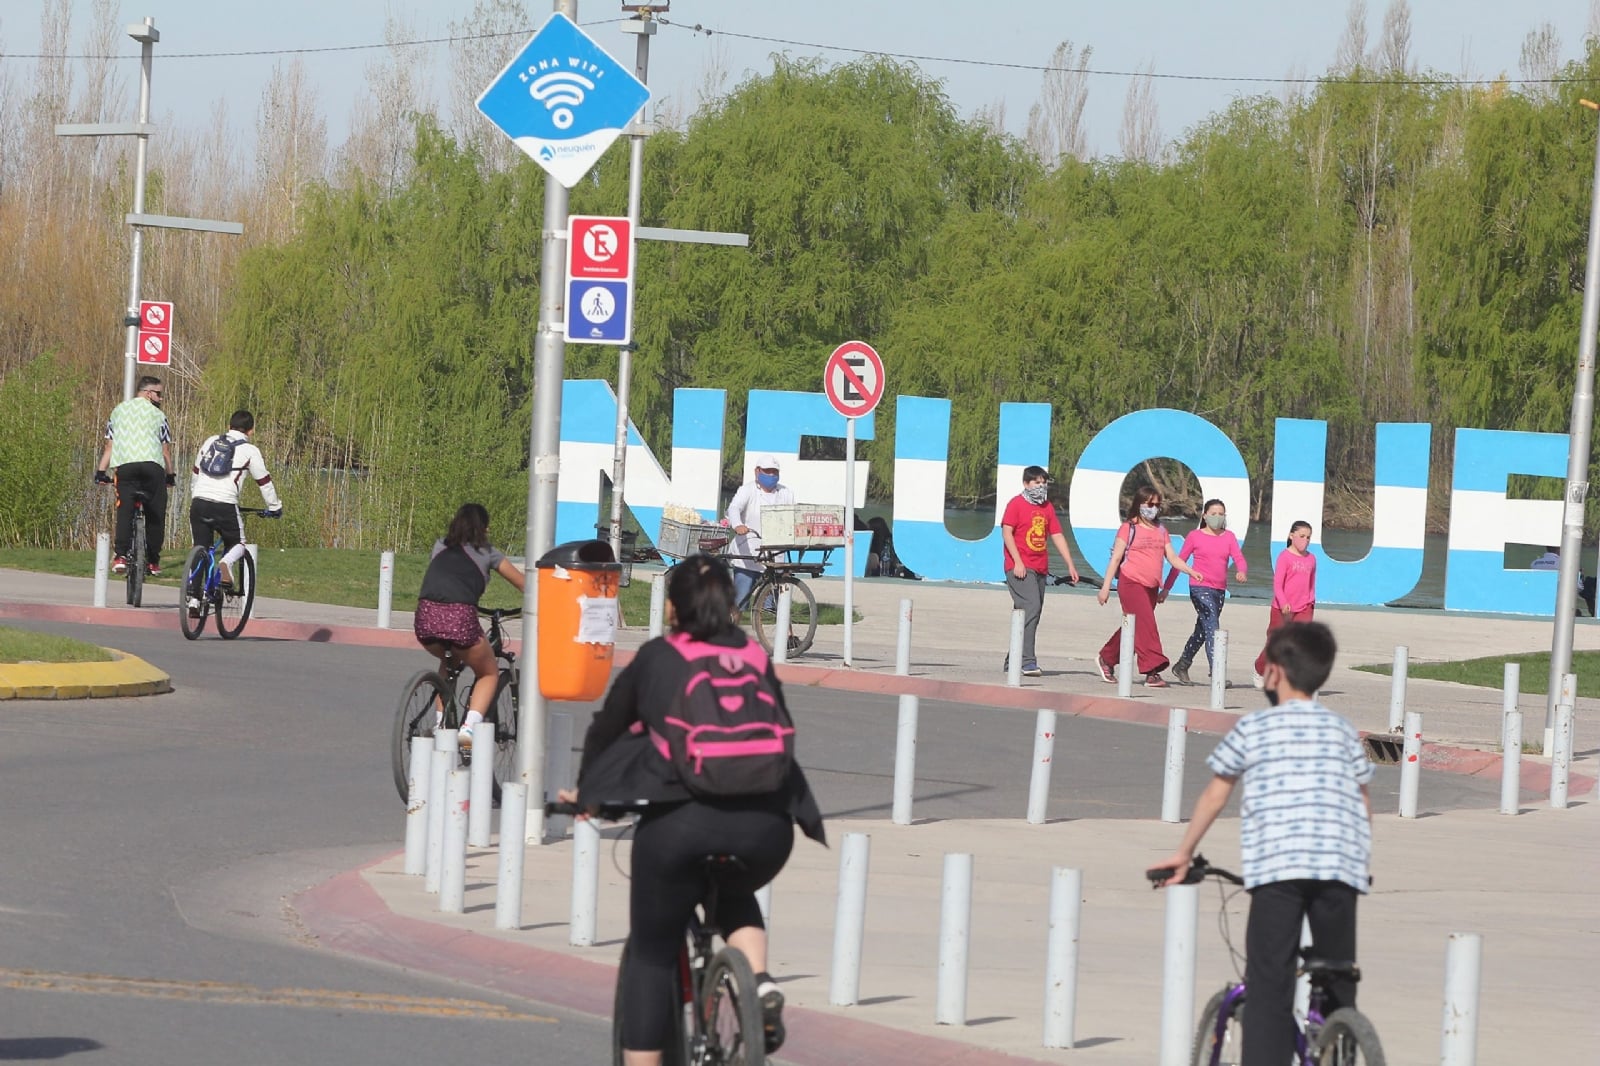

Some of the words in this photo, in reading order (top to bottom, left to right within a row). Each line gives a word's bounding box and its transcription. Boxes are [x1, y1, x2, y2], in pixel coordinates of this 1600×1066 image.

[518, 57, 560, 83] ZONA
[568, 57, 605, 79] WIFI
[843, 358, 866, 400] E
[555, 378, 1600, 617] NEUQUE
